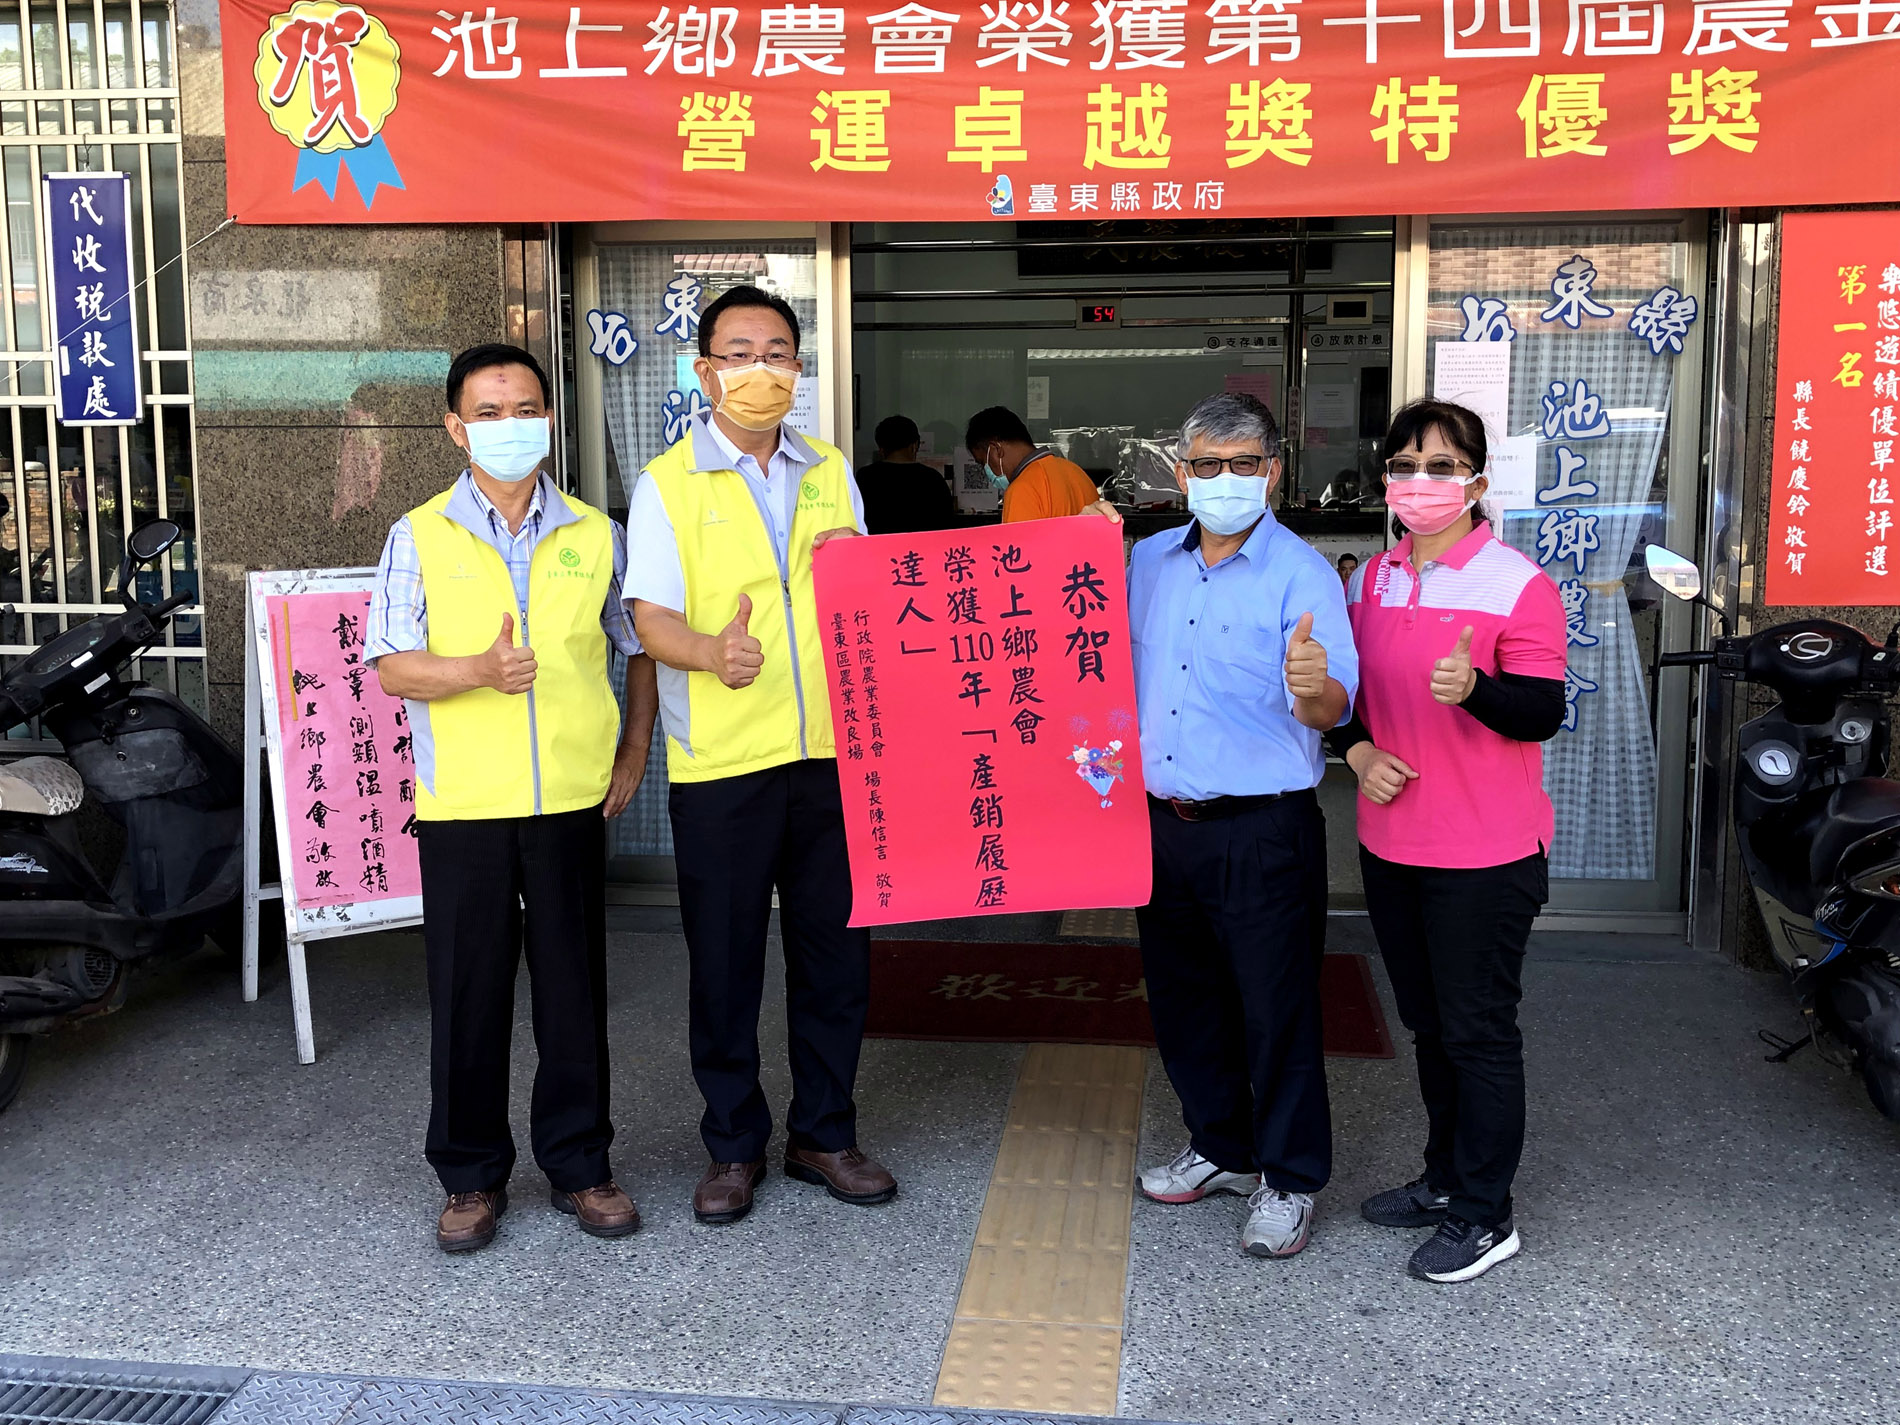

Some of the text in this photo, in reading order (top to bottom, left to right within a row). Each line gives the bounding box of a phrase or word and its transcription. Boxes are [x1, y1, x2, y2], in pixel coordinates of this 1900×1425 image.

[270, 8, 374, 147] 賀
[678, 66, 1763, 173] 營運卓越獎特優獎
[1028, 180, 1225, 213] 臺東縣政府
[70, 185, 118, 418] 代收稅款處
[1093, 306, 1115, 321] 54
[1328, 333, 1383, 347] 放款計息
[1831, 264, 1867, 388] 第一名
[854, 610, 886, 758] 行政院農業委員會
[992, 545, 1046, 745] 池上鄉農會
[1062, 561, 1110, 684] 恭賀
[831, 612, 864, 760] 臺東區農業改良場
[876, 873, 893, 908] 敬賀
